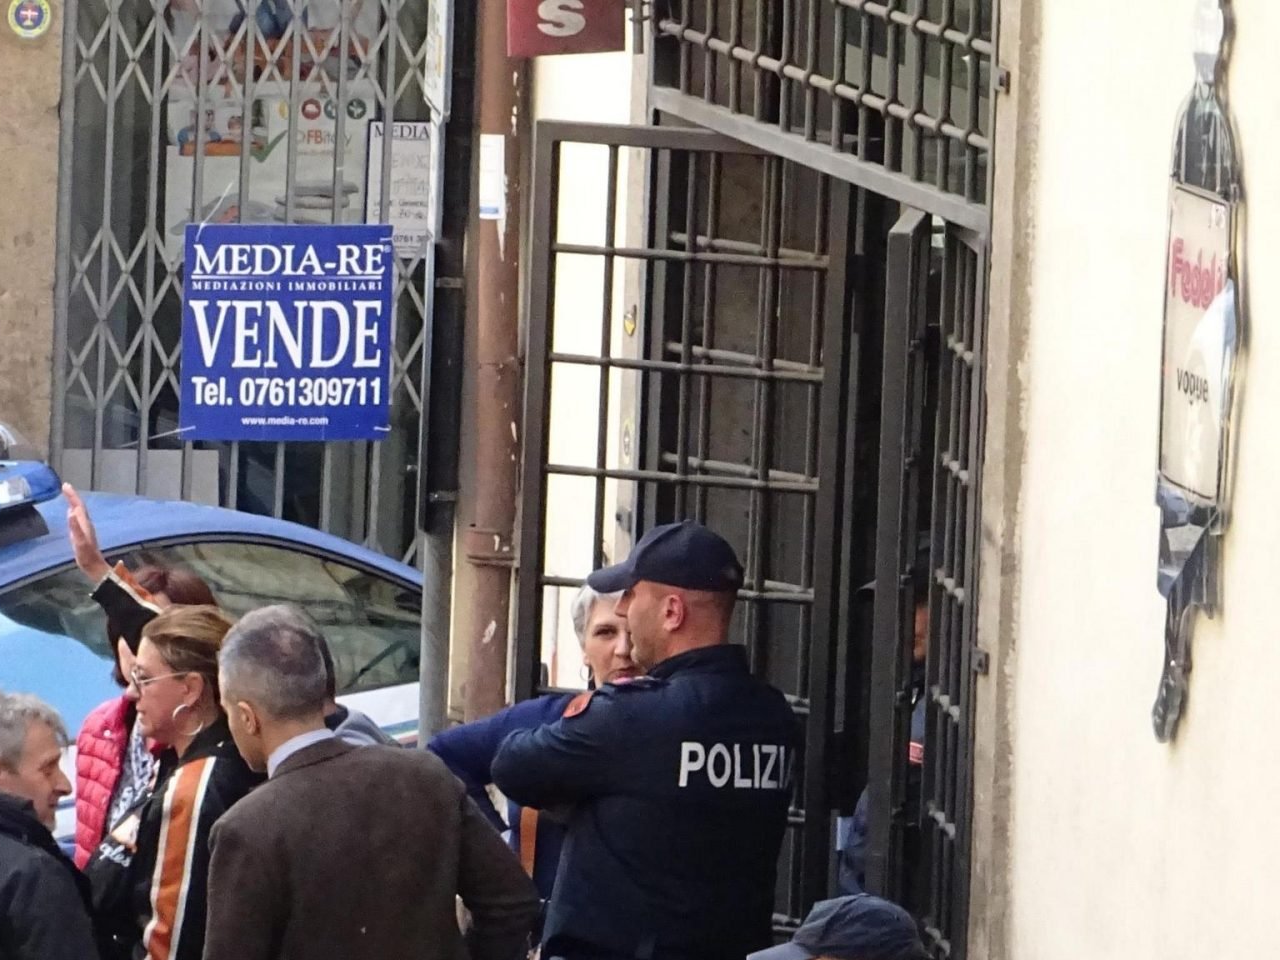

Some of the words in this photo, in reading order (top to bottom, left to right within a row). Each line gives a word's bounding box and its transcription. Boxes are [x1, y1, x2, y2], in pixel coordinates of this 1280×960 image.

[193, 244, 386, 276] MEDIA-RE
[192, 281, 281, 291] MEDIAZIONI
[288, 281, 383, 291] IMMOBILIARI
[189, 299, 383, 369] VENDE
[191, 376, 233, 405] Tel.
[239, 377, 381, 406] 0761309711
[241, 416, 329, 426] www.media-re.com
